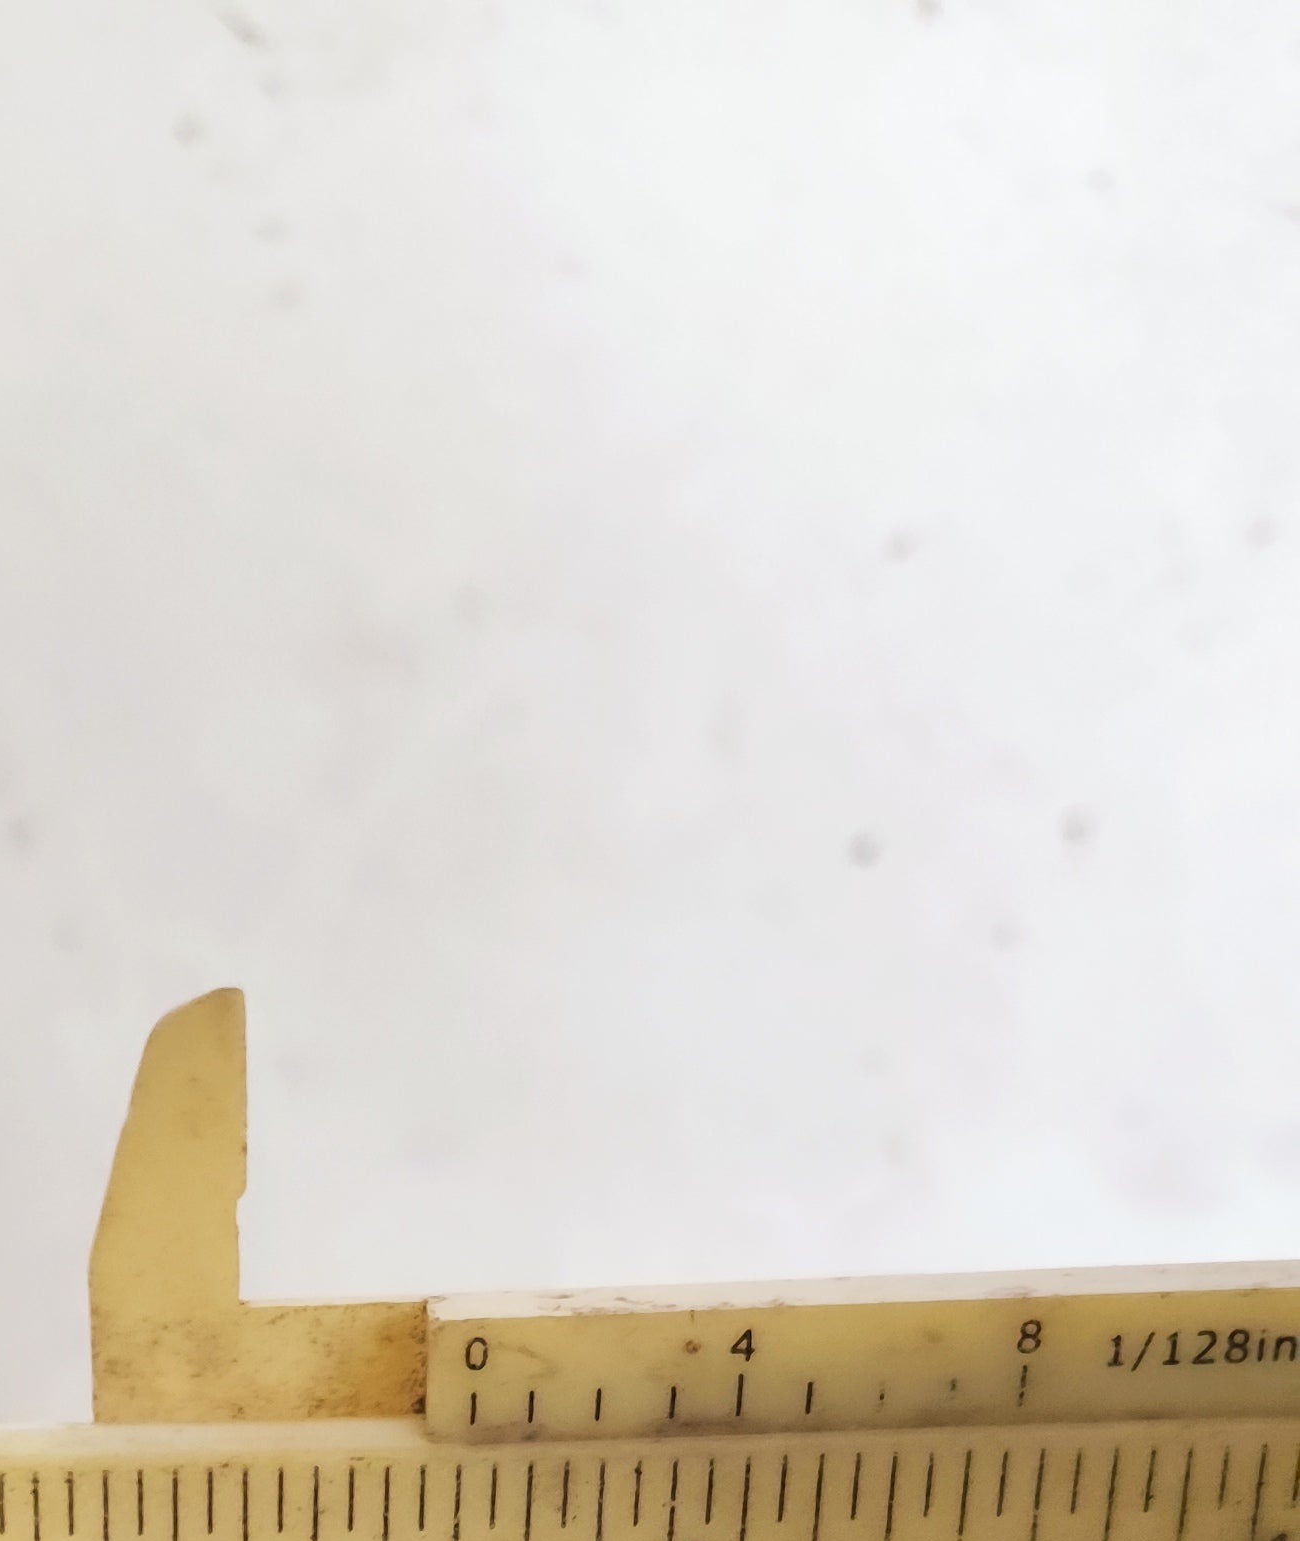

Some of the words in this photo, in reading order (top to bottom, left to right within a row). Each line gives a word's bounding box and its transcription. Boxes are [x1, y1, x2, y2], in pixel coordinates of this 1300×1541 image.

[466, 1337, 488, 1370] 0
[730, 1329, 755, 1362] 4
[1017, 1320, 1042, 1354] 8
